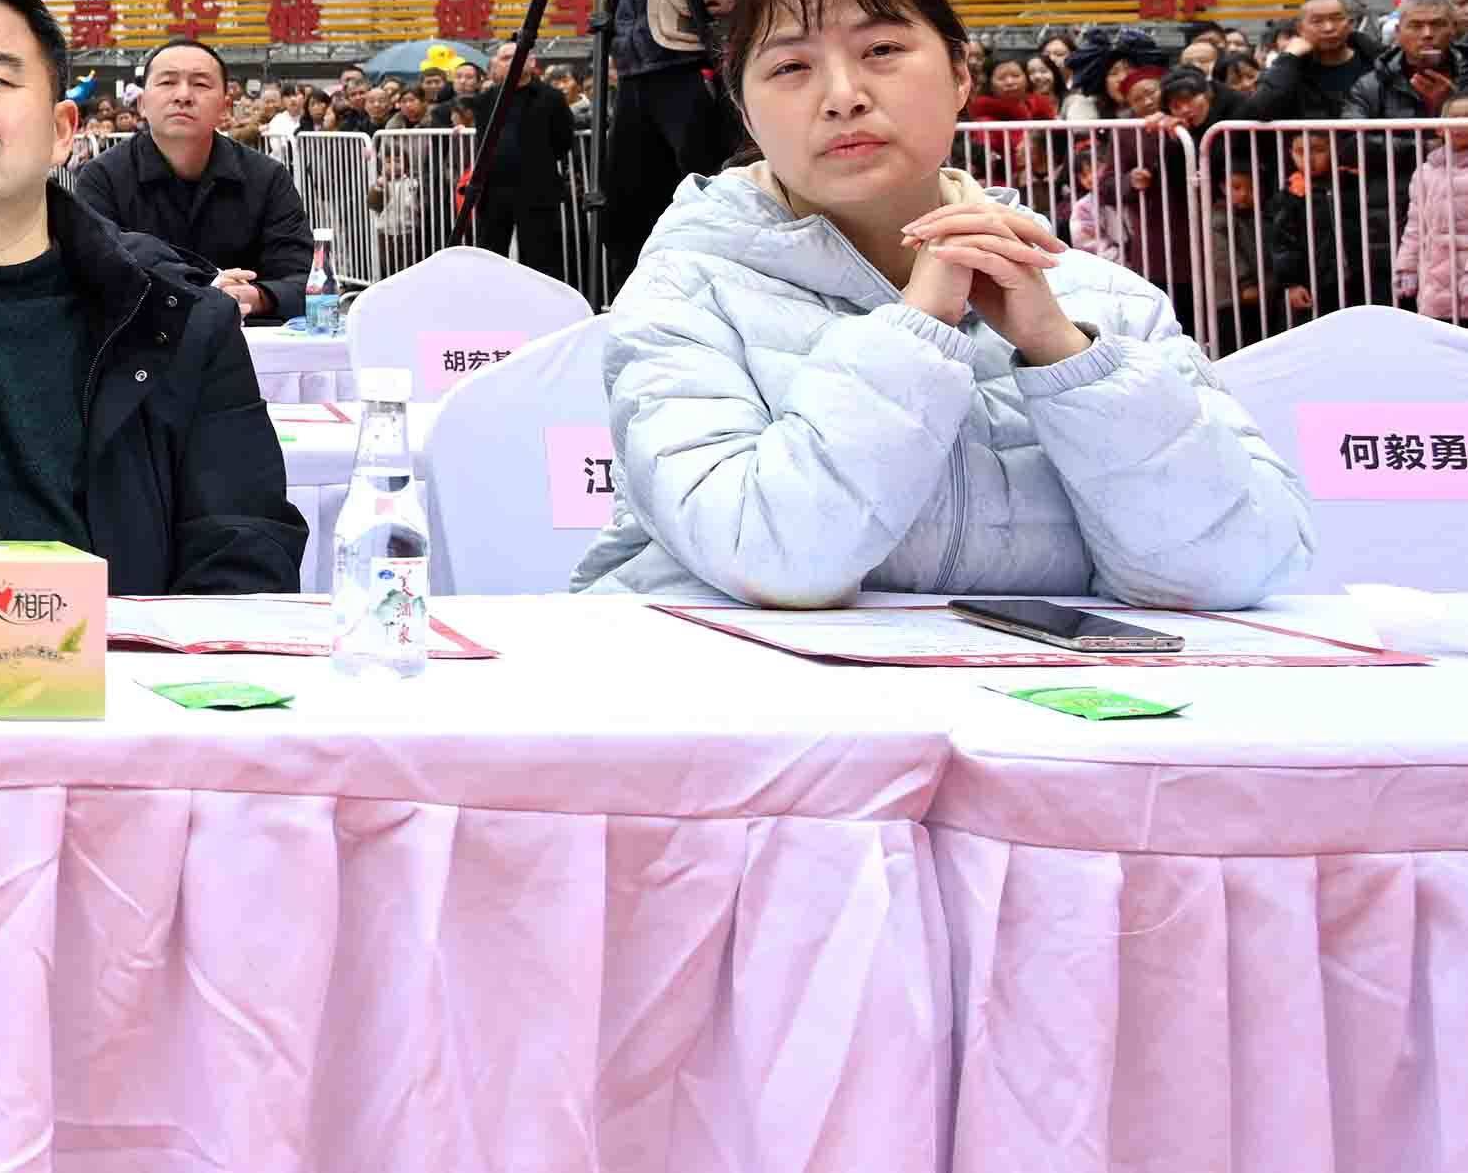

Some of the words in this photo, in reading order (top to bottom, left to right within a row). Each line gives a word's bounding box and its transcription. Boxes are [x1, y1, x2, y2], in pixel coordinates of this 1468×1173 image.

[1339, 433, 1468, 471] 何毅勇
[584, 457, 616, 495] 江
